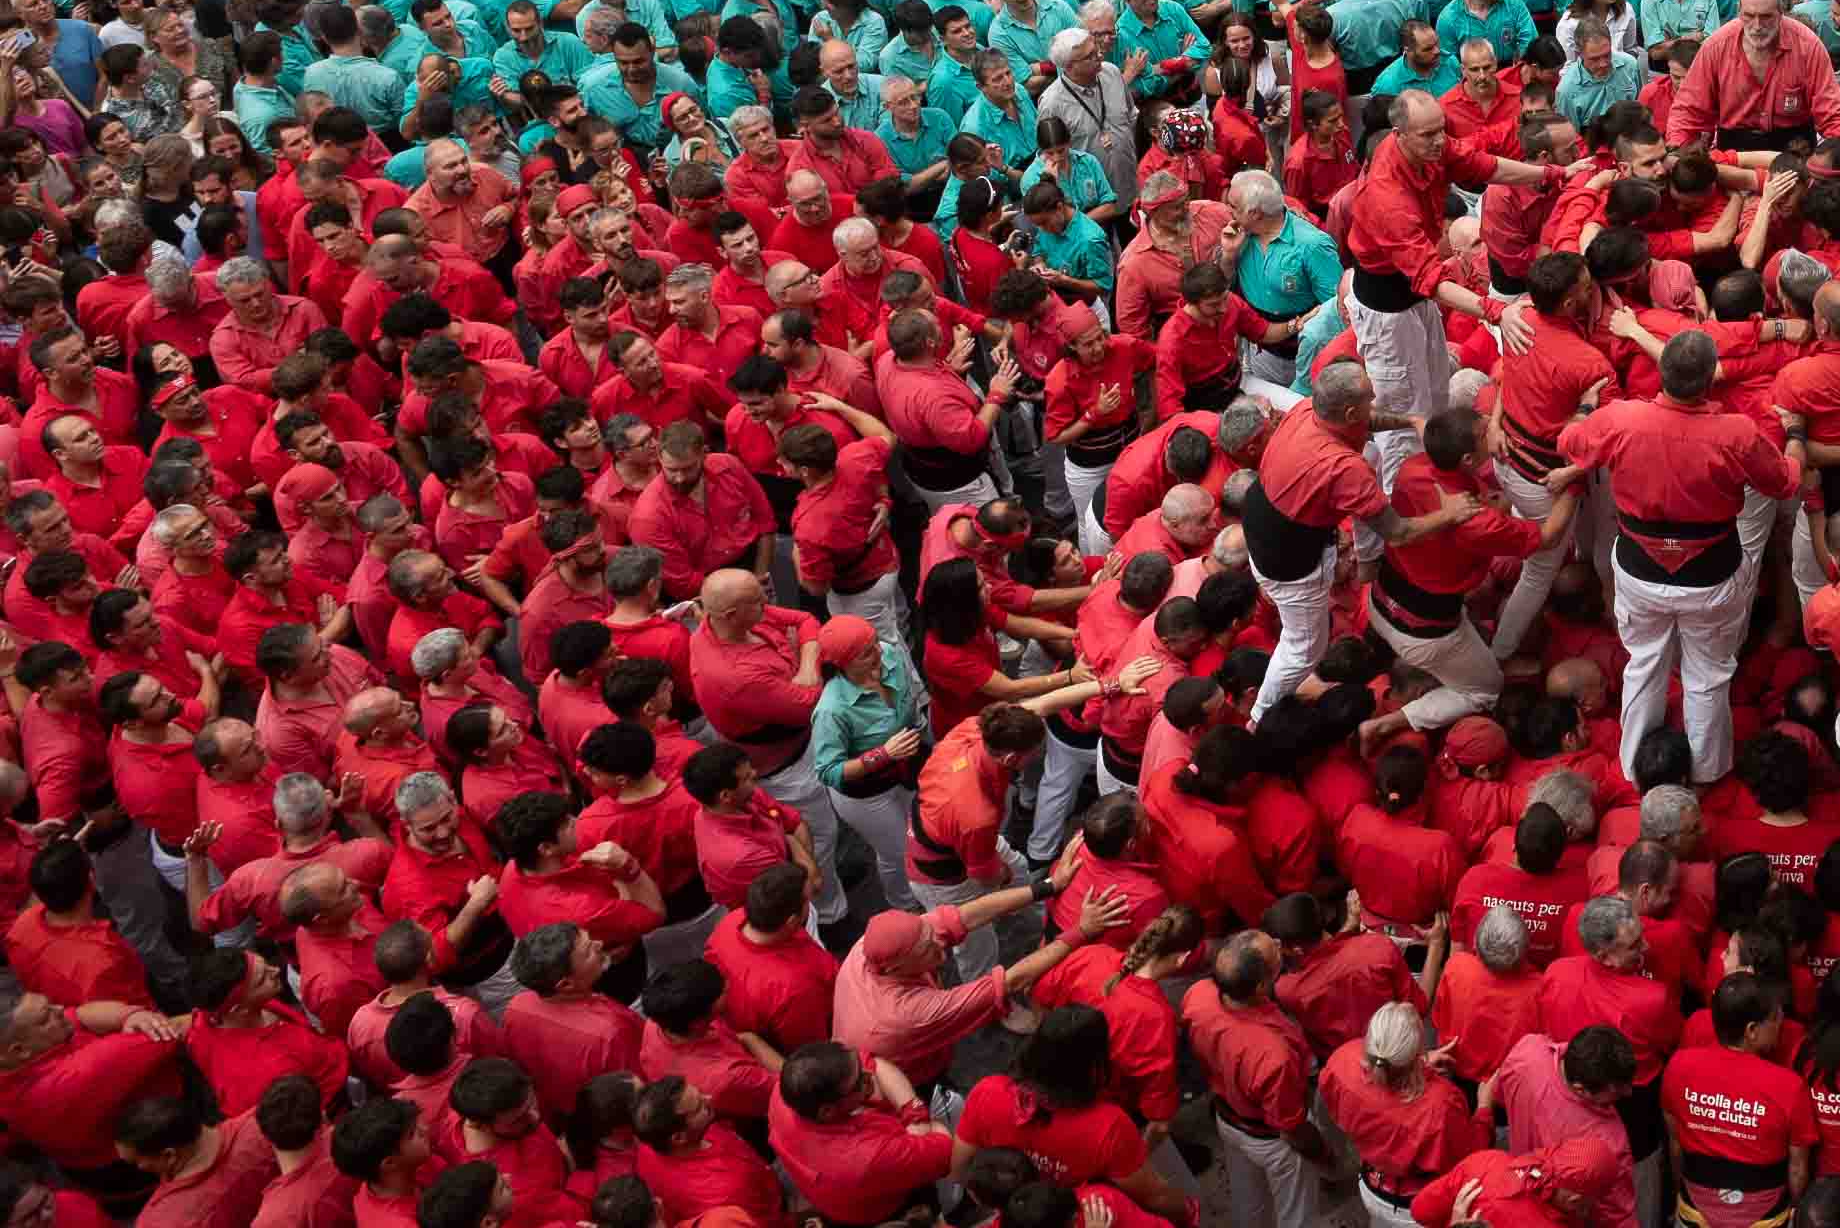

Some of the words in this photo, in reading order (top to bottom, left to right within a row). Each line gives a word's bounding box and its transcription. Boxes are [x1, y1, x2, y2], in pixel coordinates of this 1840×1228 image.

[1483, 895, 1535, 913] nascuts
[1537, 902, 1563, 917] per
[1684, 1087, 1698, 1102] La
[1700, 1093, 1731, 1109] colla
[1733, 1098, 1751, 1112] de
[1753, 1101, 1766, 1116] la
[1811, 1087, 1825, 1102] La
[1689, 1103, 1716, 1119] teva
[1719, 1110, 1759, 1127] ciutat
